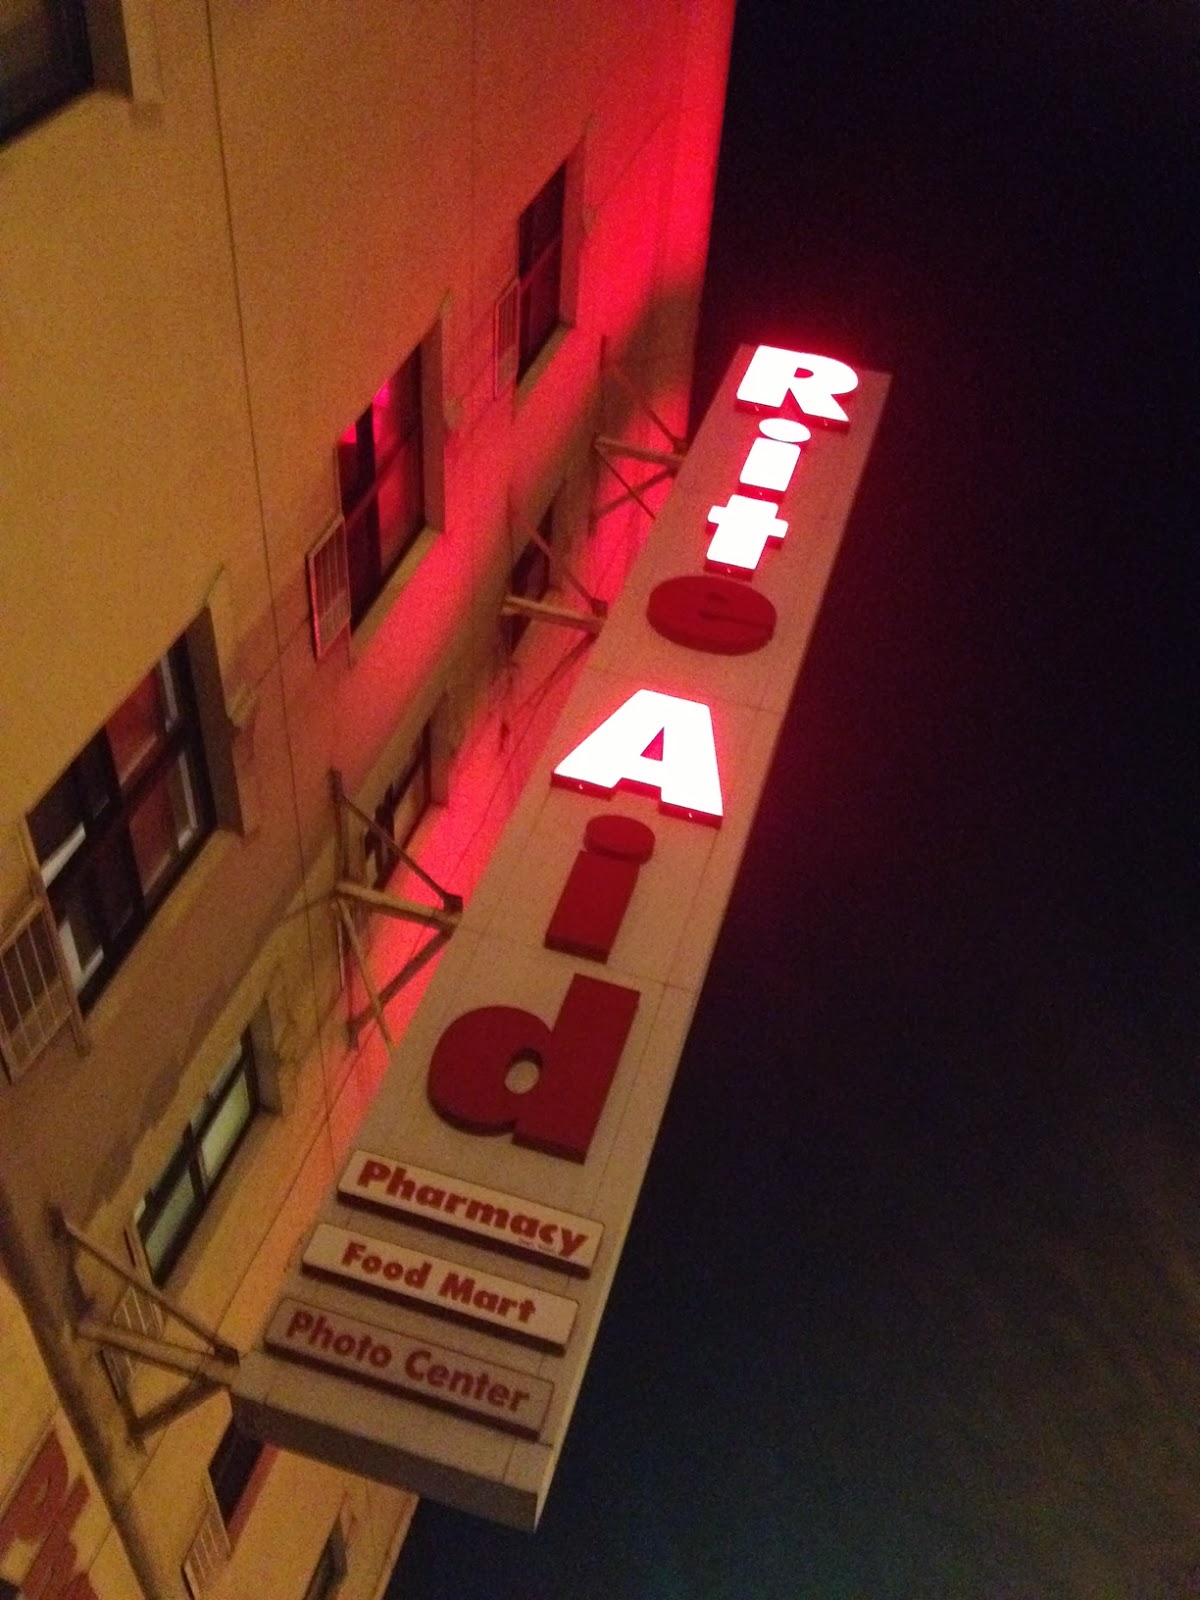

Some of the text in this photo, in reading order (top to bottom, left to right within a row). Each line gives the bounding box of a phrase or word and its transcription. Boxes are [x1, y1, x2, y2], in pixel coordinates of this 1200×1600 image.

[427, 345, 859, 1162] Rite Aid
[358, 1160, 588, 1257] Pharmacy
[341, 1242, 536, 1323] Food Mart
[286, 1310, 530, 1412] Photo Center
